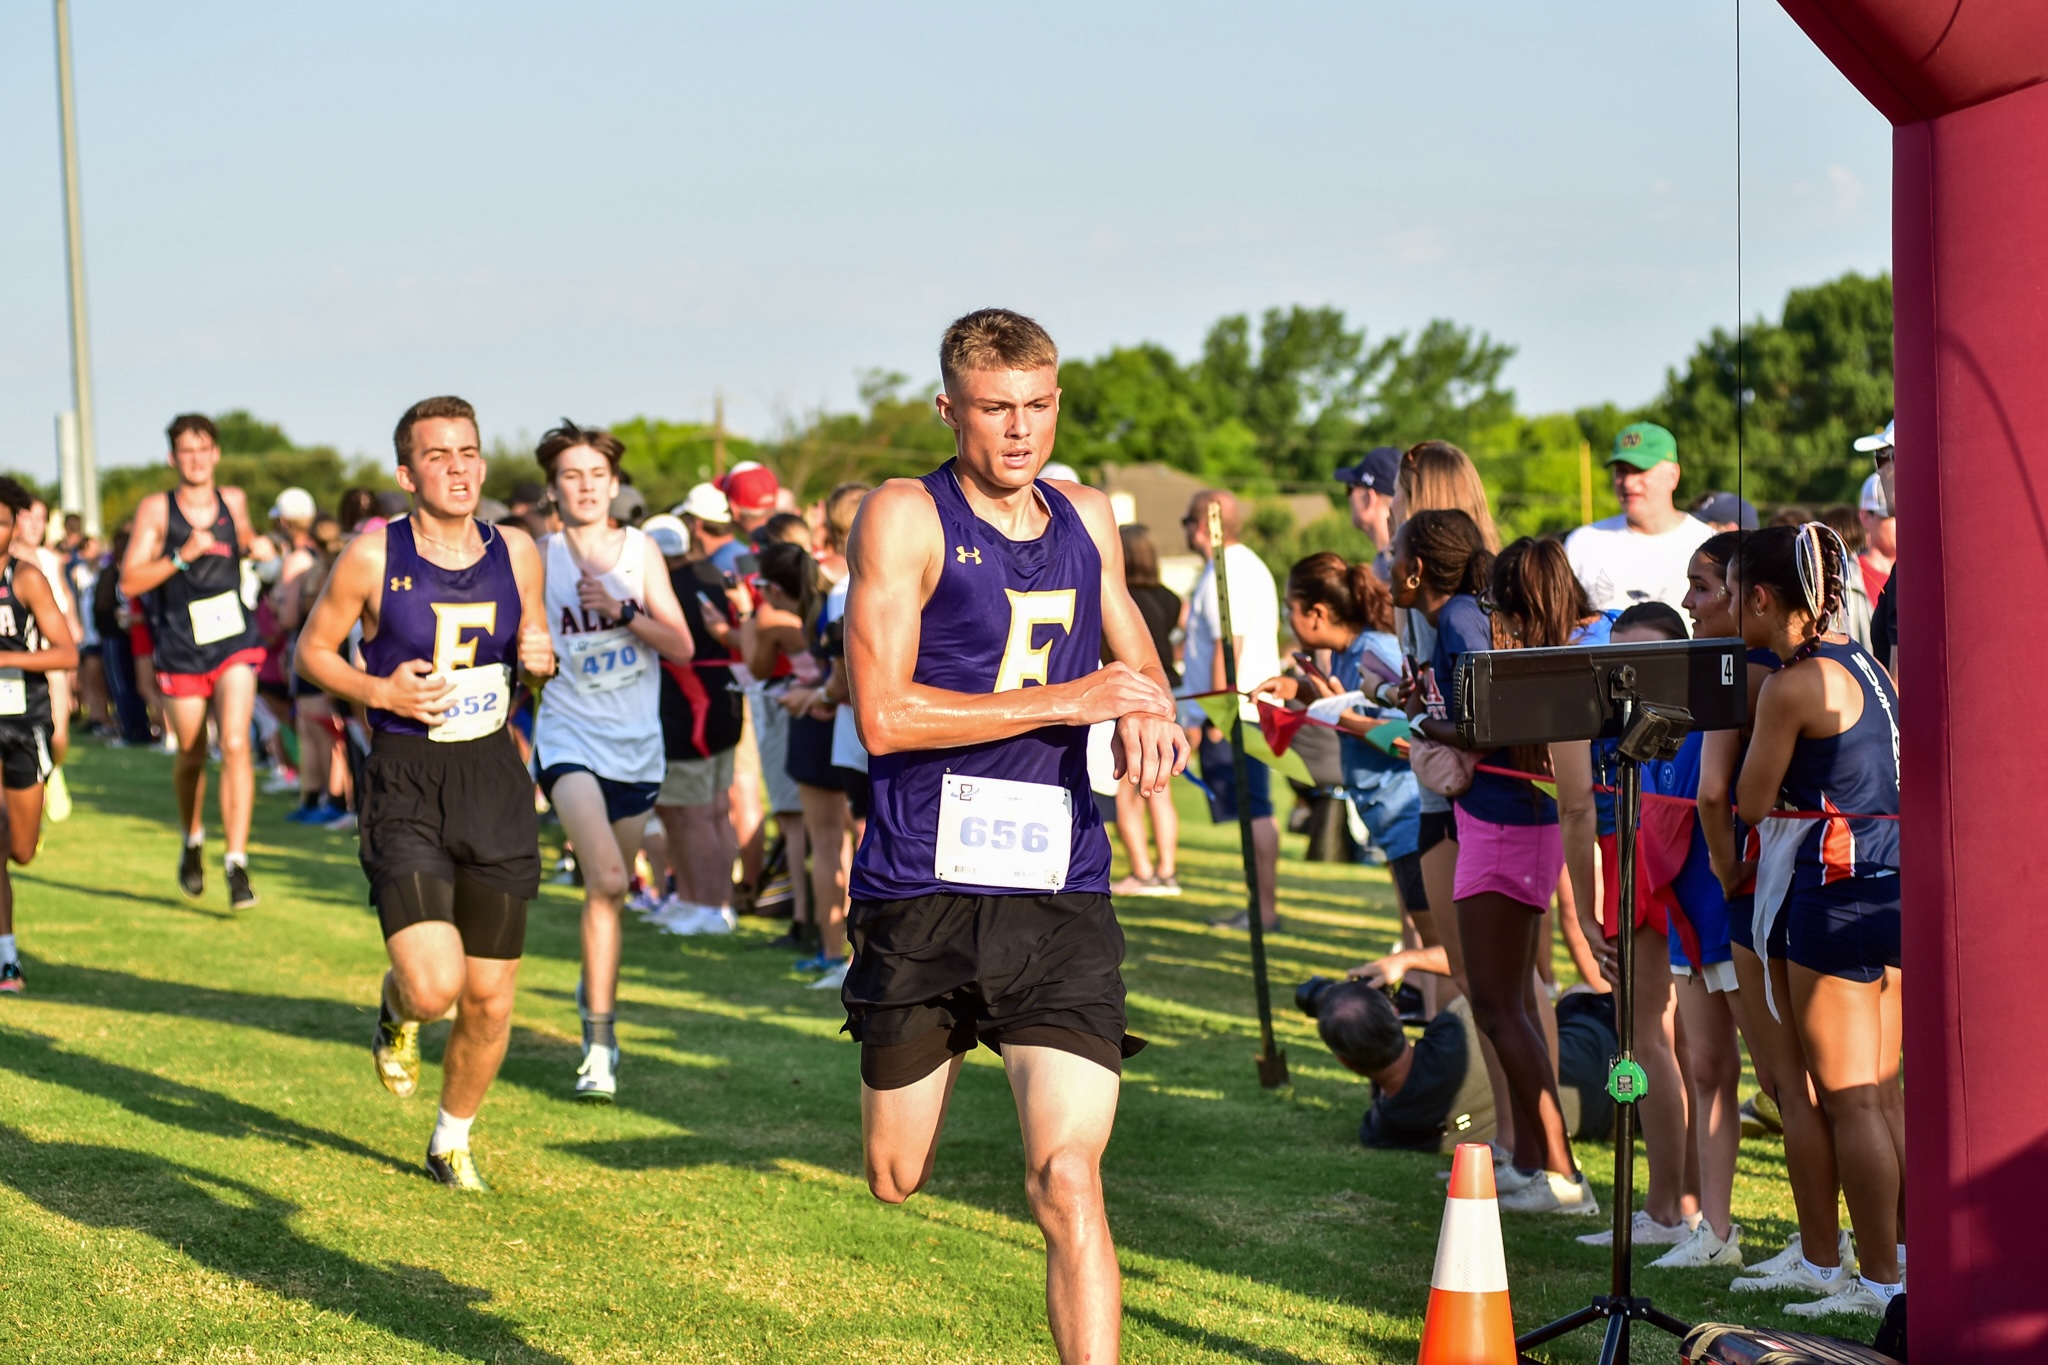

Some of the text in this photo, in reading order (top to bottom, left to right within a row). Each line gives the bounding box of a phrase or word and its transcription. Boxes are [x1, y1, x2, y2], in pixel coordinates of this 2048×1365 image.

[562, 598, 645, 635] ALL
[430, 601, 497, 674] F
[993, 587, 1077, 694] F
[582, 646, 638, 675] 470
[1724, 656, 1733, 684] 4
[1851, 652, 1900, 792] MUSTAN
[960, 816, 1049, 853] 656
